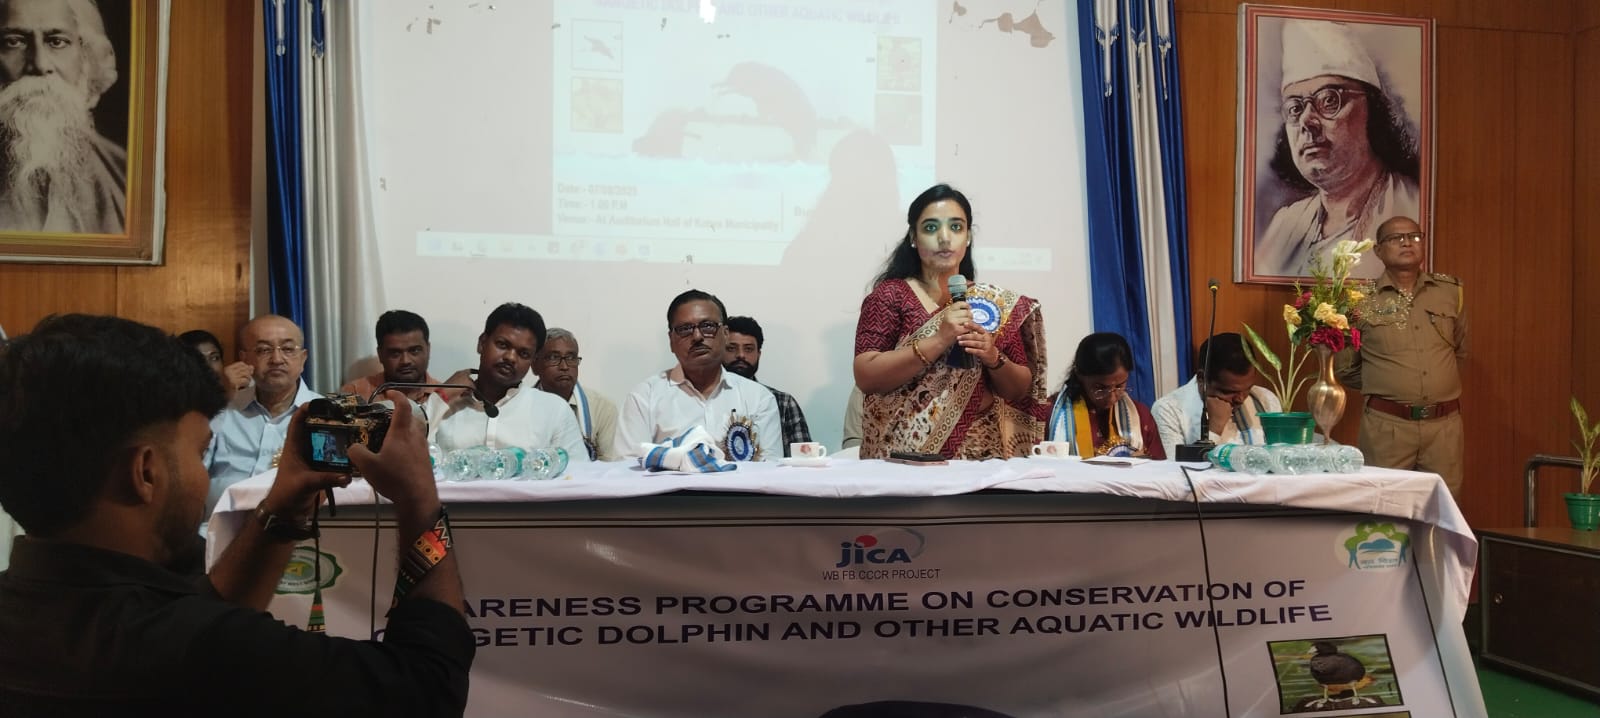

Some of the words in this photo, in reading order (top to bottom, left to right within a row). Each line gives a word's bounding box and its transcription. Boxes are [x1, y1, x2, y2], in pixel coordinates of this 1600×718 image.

[823, 570, 840, 581] WB
[858, 569, 889, 580] CCCR
[892, 568, 941, 579] PROJECT
[655, 592, 909, 615] PROGRAMME
[921, 590, 974, 610] ON
[986, 581, 1252, 608] CONSERVATION
[1263, 579, 1306, 598] OF
[598, 622, 770, 645] DOLPHIN
[780, 620, 862, 641] AND
[873, 617, 1001, 638] OTHER
[1009, 611, 1164, 635] AQUATIC
[1174, 603, 1333, 629] WILDLIFE
